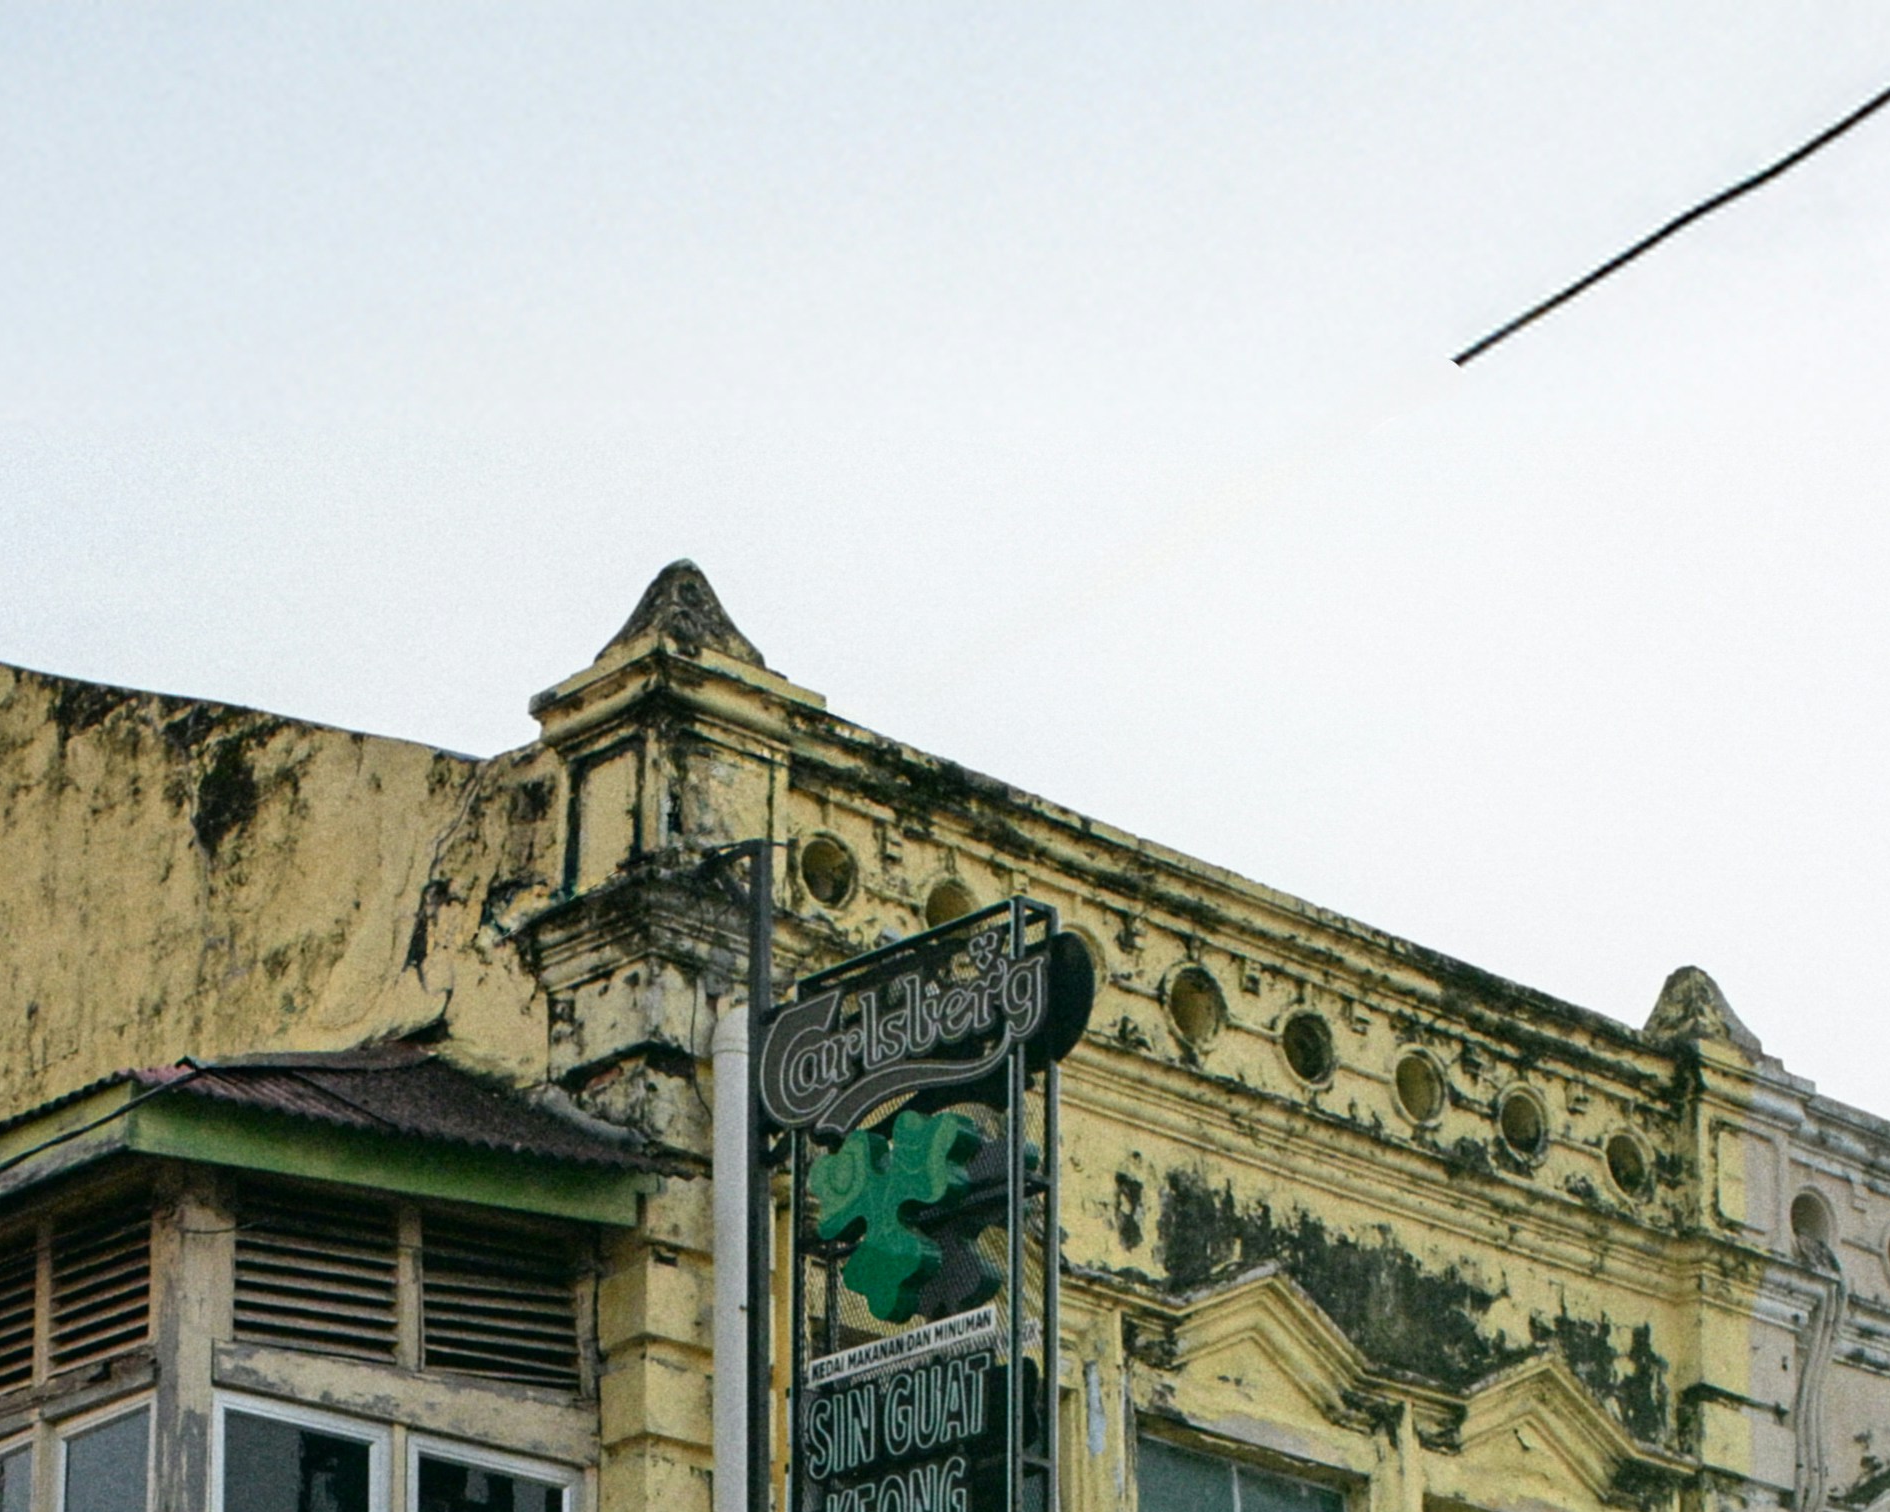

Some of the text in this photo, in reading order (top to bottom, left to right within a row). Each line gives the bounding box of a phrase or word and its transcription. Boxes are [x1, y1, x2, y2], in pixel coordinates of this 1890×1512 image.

[761, 955, 1046, 1133] Carlsberg
[812, 1310, 992, 1380] KEDAI MAKANAN DAN MINUMAN
[810, 1352, 990, 1479] SIN GUAT
